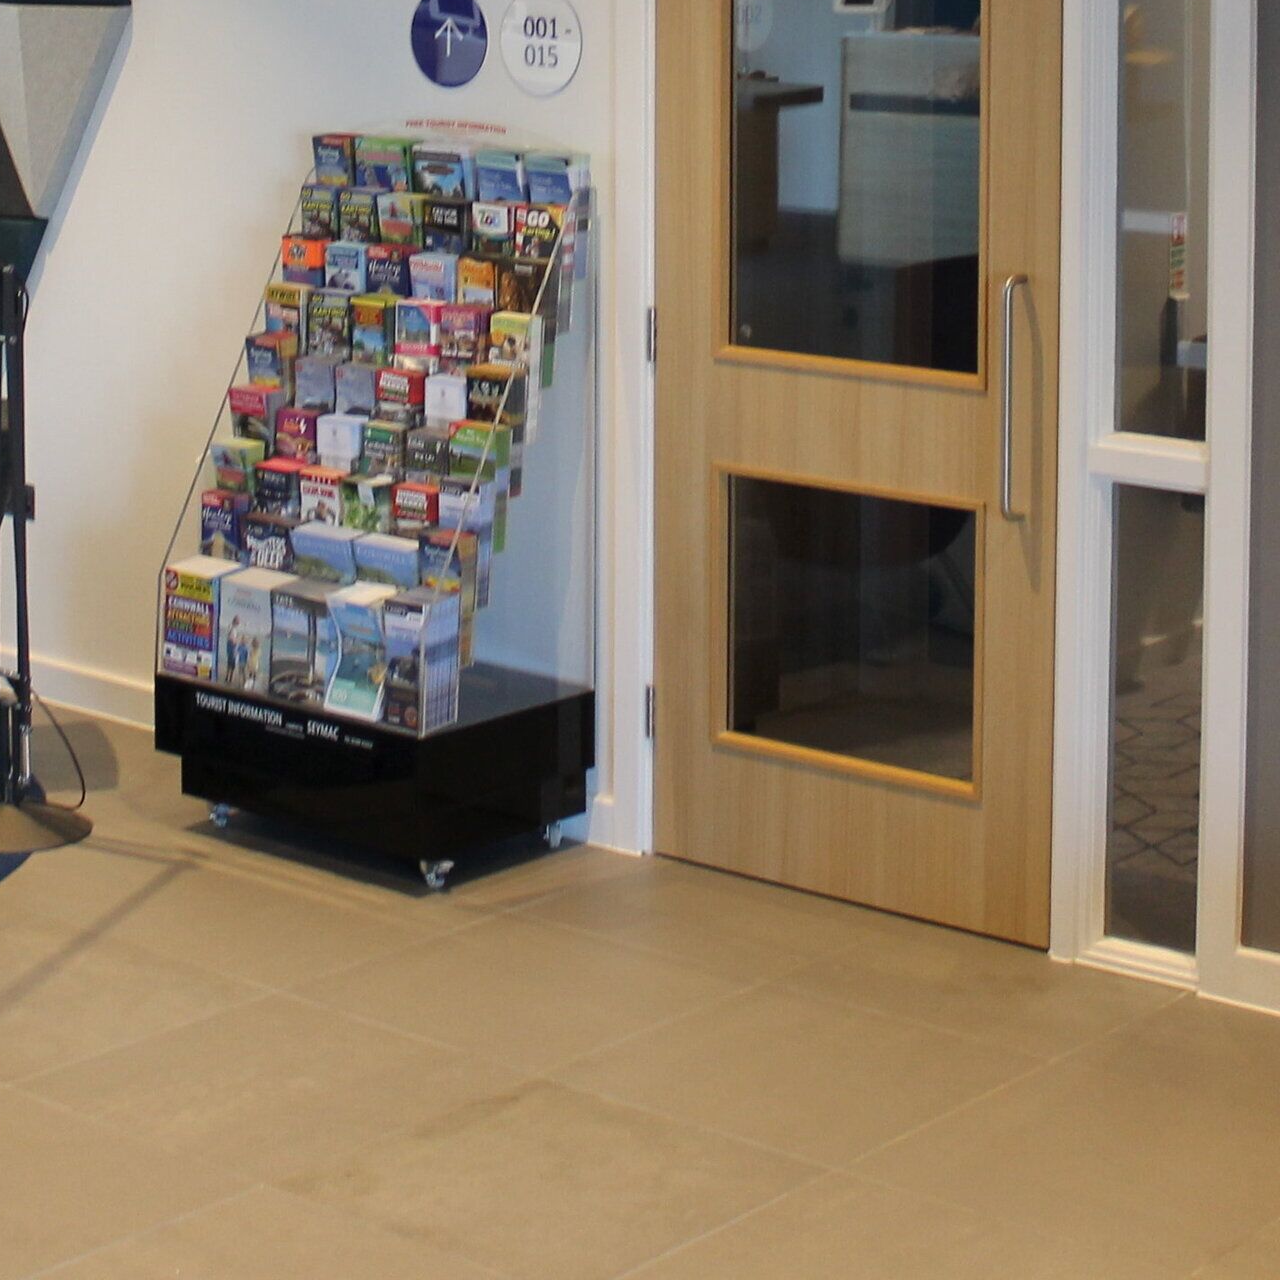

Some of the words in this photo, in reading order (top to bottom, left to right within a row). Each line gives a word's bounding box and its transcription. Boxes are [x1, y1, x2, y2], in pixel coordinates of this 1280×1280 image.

[523, 16, 557, 39] 001
[524, 43, 558, 67] 015
[528, 210, 550, 228] GO
[195, 691, 227, 710] TOURIST
[228, 699, 283, 727] INFORMATION
[307, 719, 340, 742] SEYMAC
